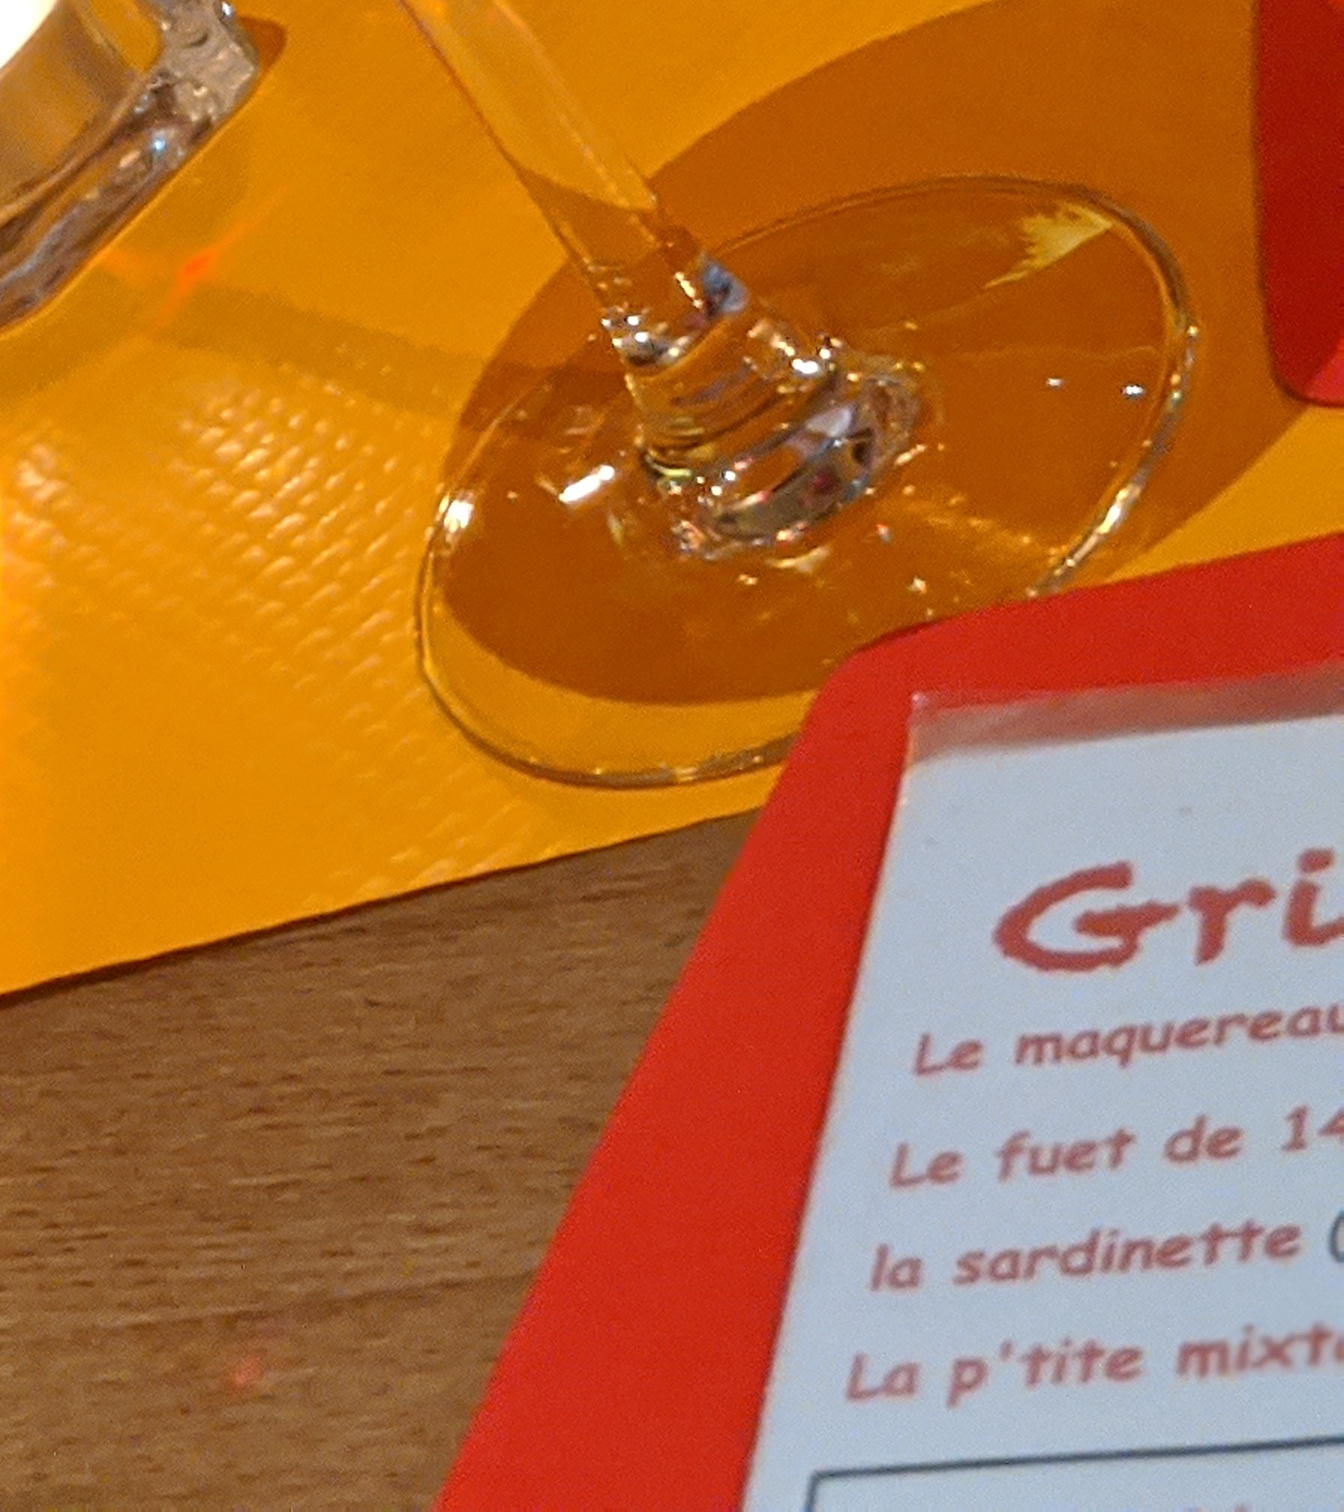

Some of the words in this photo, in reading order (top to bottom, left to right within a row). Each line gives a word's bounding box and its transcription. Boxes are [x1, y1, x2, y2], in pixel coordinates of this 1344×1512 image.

[993, 847, 1344, 974] Gri
[914, 1034, 983, 1076] Le
[890, 1144, 962, 1189] Le
[998, 1129, 1136, 1182] fuet
[1164, 1116, 1244, 1165] de
[871, 1246, 923, 1291] la
[954, 1221, 1302, 1285] sardinette
[847, 1355, 920, 1402] La
[949, 1340, 1144, 1406] p'tite
